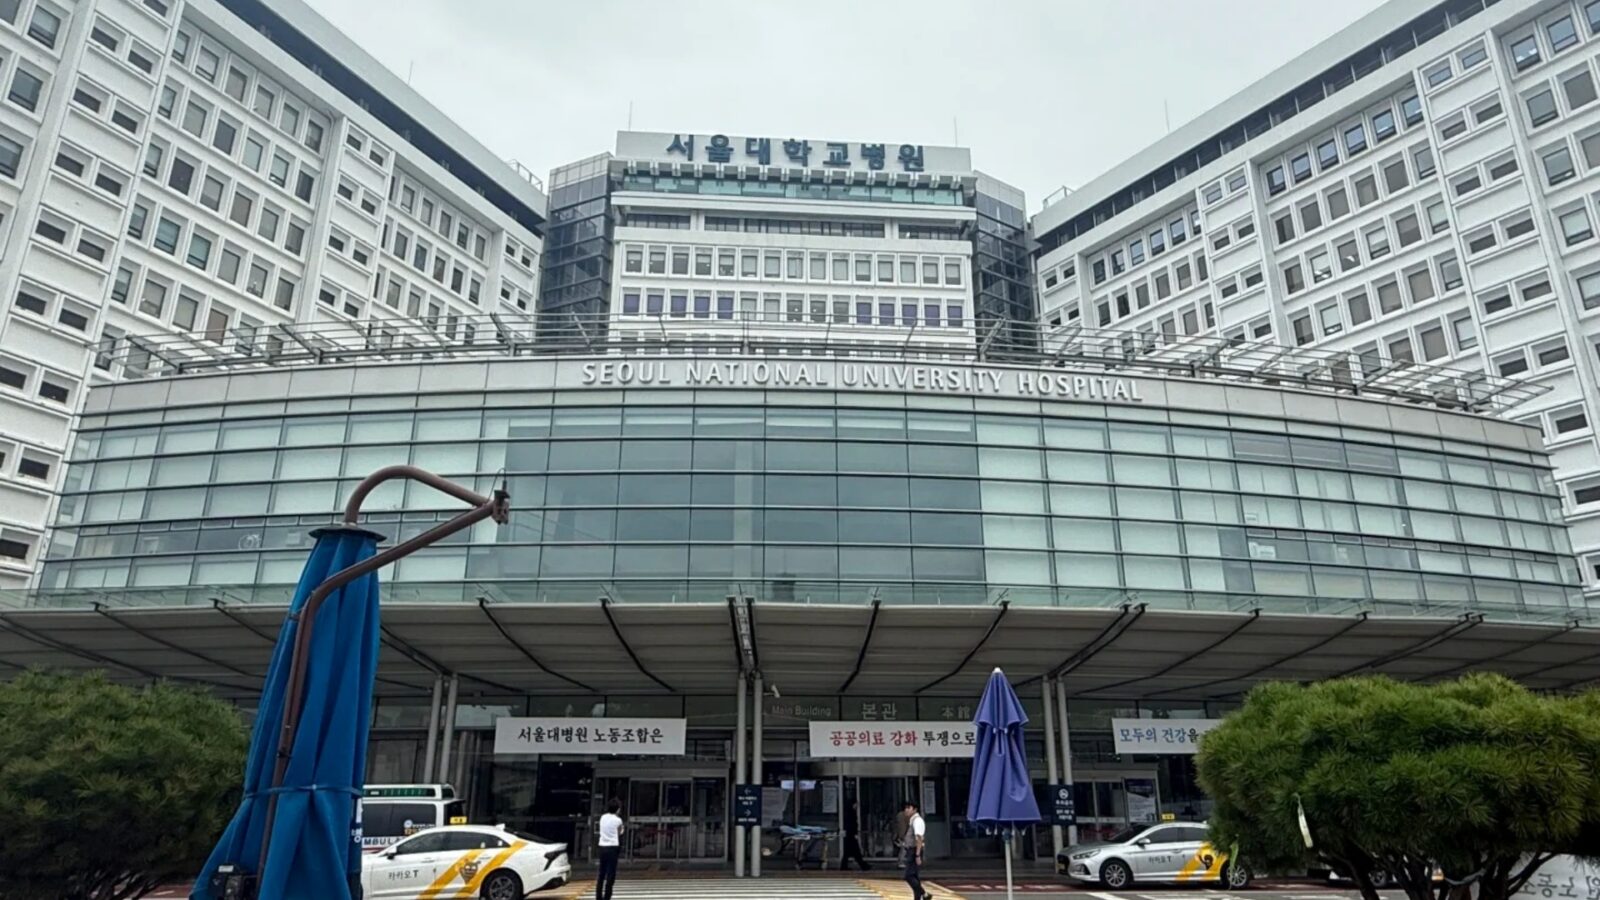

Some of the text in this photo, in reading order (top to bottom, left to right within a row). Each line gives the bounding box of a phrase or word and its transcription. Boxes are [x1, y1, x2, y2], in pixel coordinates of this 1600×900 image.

[666, 134, 925, 172] 서울대학교병원
[582, 361, 1143, 402] SEOUL NATIONAL UNIVERSITY HOSPITAL
[772, 705, 832, 717] Main Building
[861, 703, 898, 720] 본관
[518, 726, 664, 743] 서울대병원 노동조합은
[829, 731, 976, 747] 공공의료 강화 투쟁으로
[1120, 727, 1199, 743] 모두의 건강을
[388, 869, 419, 881] 카카오 T
